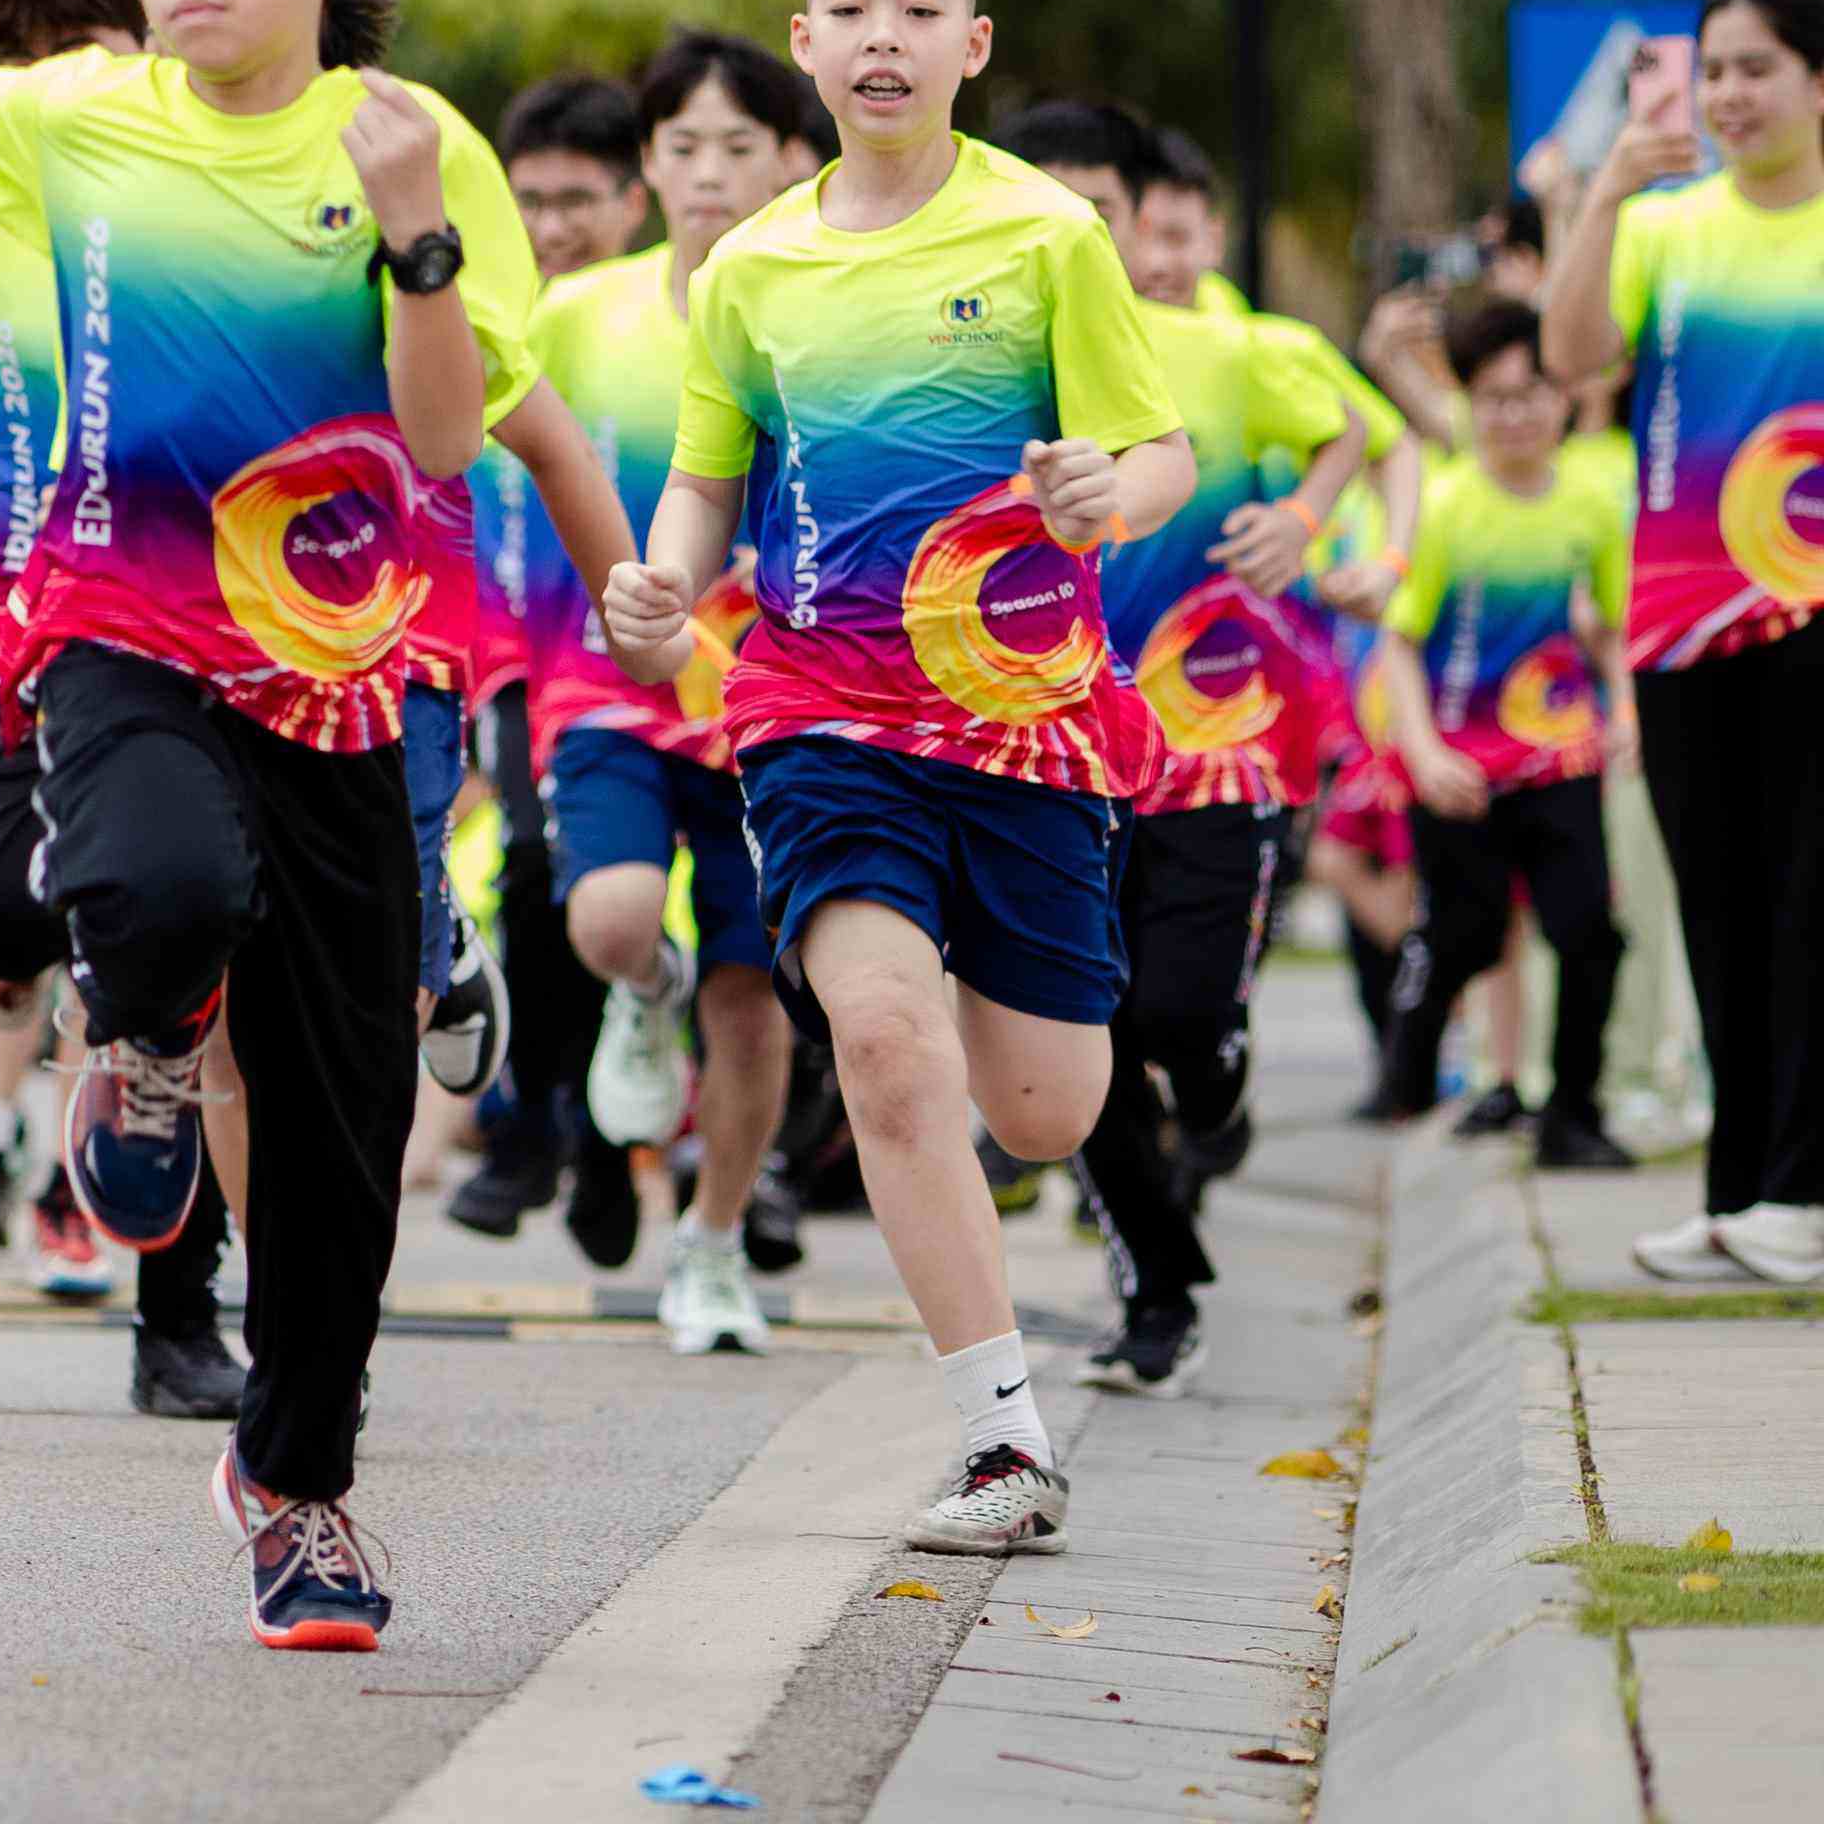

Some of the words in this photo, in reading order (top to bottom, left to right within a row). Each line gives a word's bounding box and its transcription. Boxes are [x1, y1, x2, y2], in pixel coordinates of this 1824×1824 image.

[83, 216, 111, 346] 2026
[3, 422, 39, 574] DURUN
[73, 349, 113, 547] EDURUN
